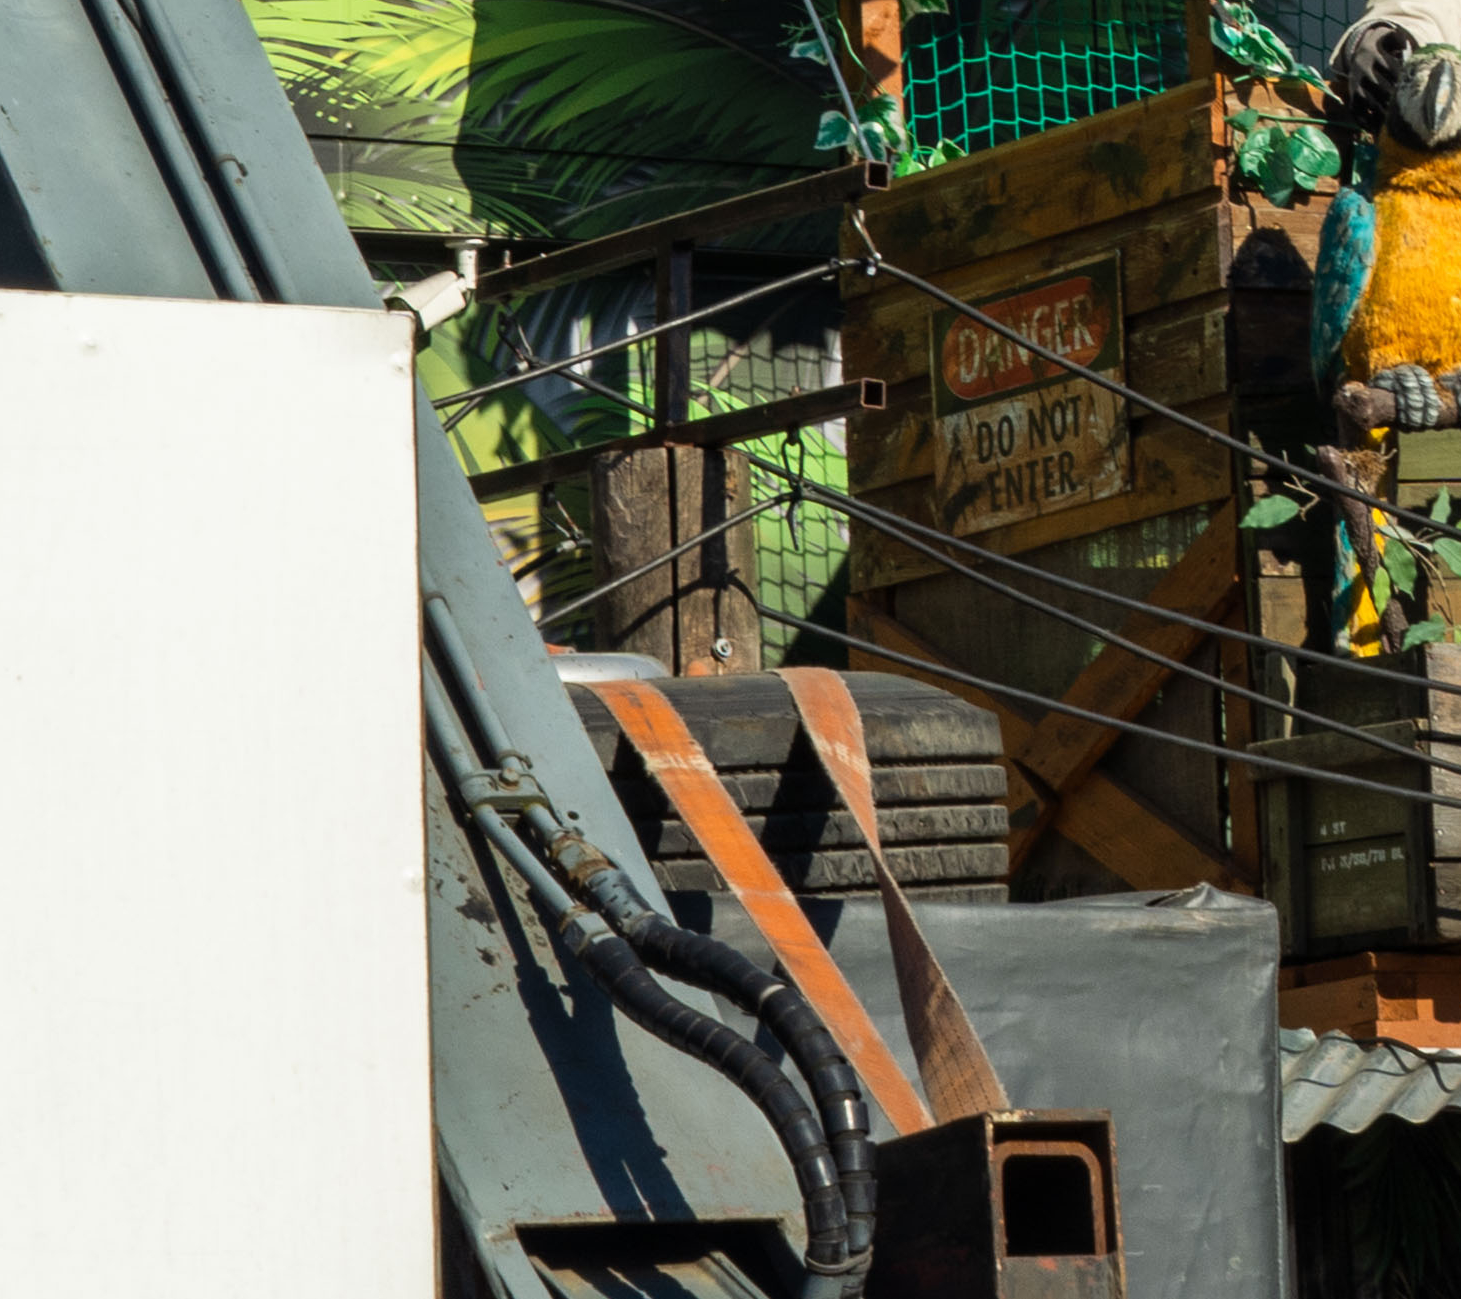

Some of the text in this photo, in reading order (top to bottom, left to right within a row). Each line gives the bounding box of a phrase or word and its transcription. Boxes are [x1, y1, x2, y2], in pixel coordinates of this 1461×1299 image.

[957, 294, 1095, 384] DANGER
[976, 394, 1083, 464] DO NOT
[987, 450, 1079, 513] ENTER
